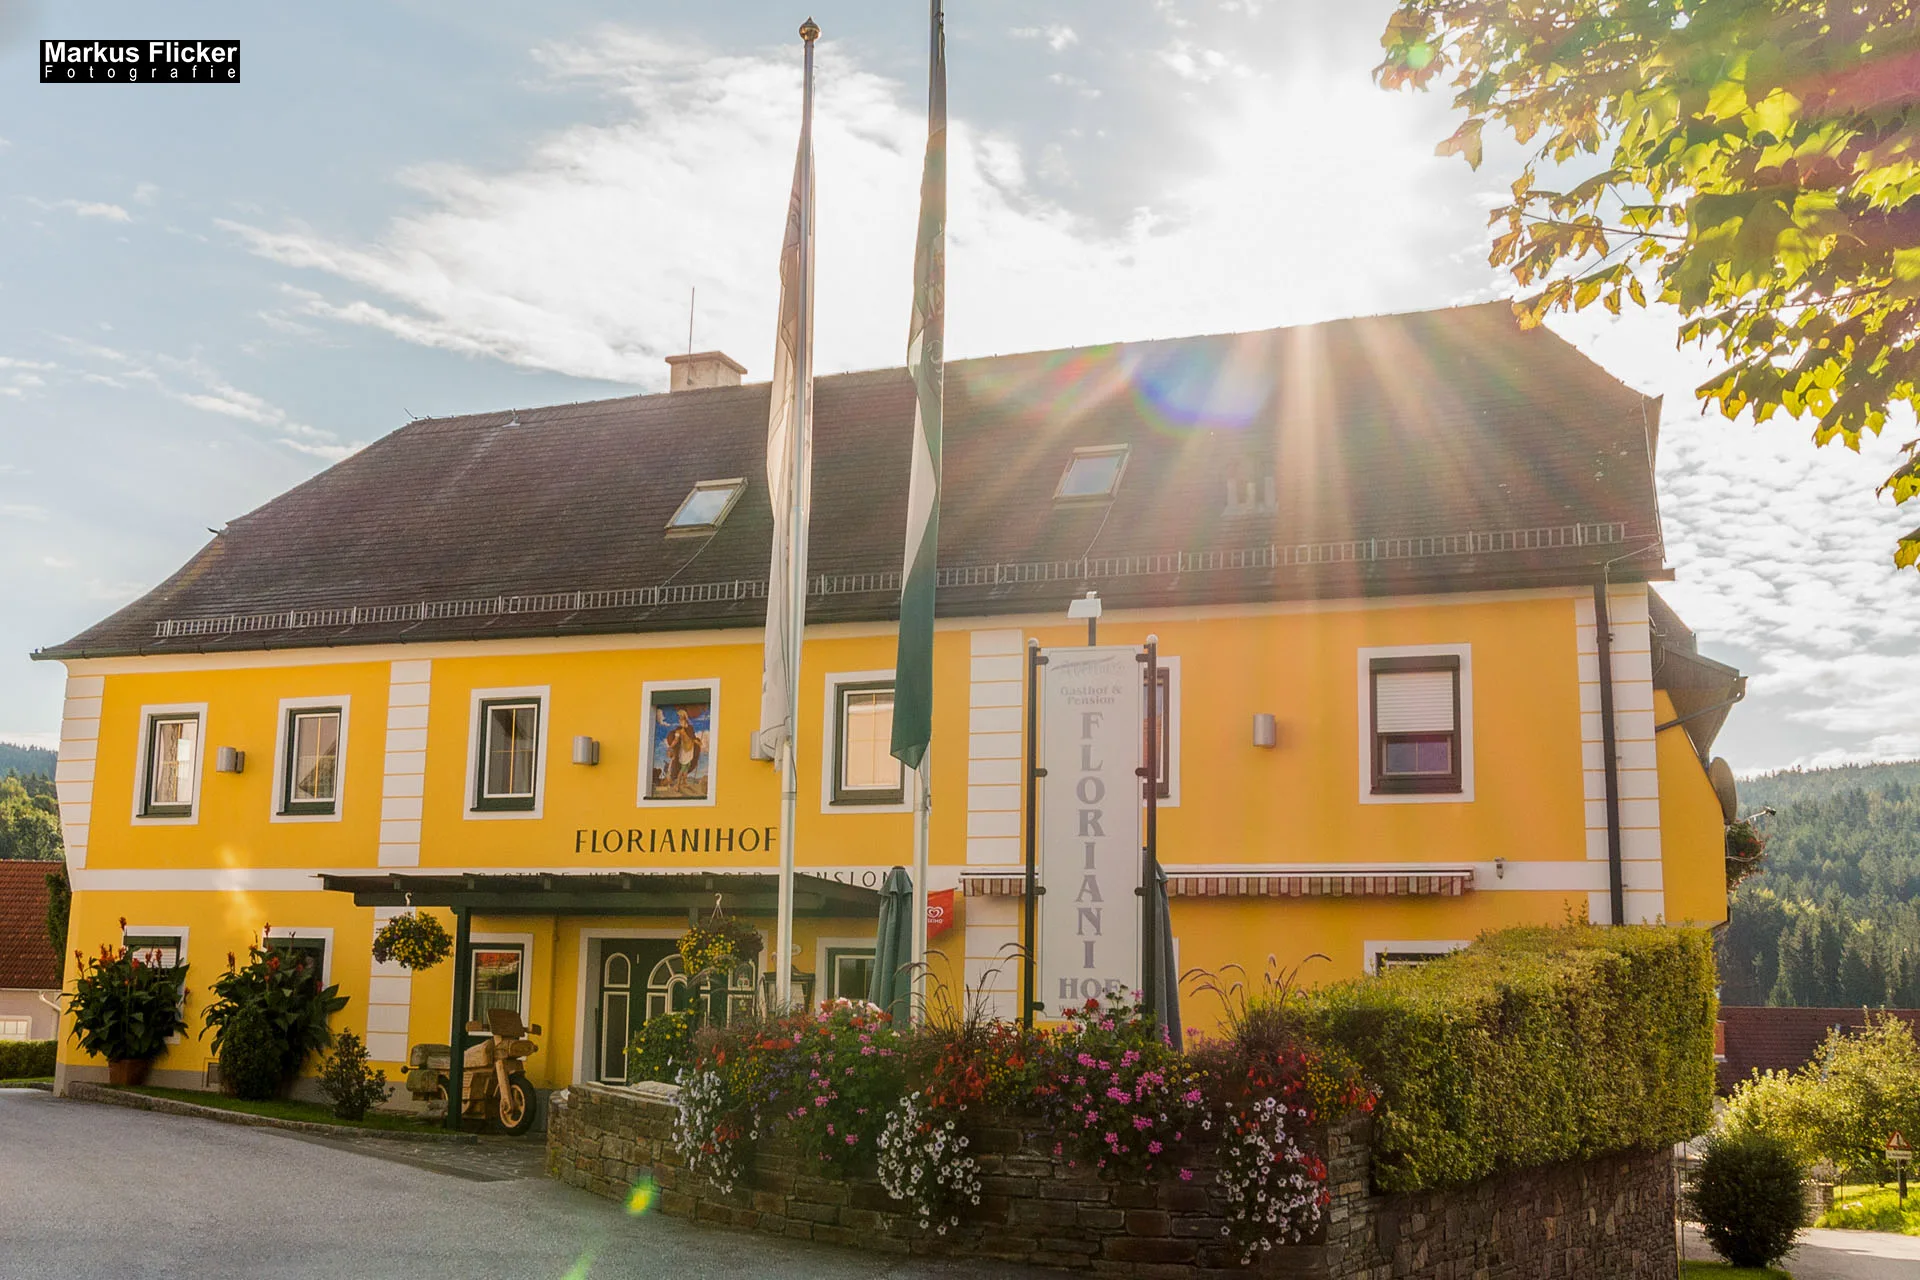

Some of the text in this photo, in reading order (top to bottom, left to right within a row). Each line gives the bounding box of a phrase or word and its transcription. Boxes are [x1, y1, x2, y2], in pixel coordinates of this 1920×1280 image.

[1067, 695, 1115, 705] Pension
[575, 827, 778, 853] FLORIANIHOF
[1076, 711, 1106, 969] FLORIANI
[1059, 977, 1121, 1000] HOF
